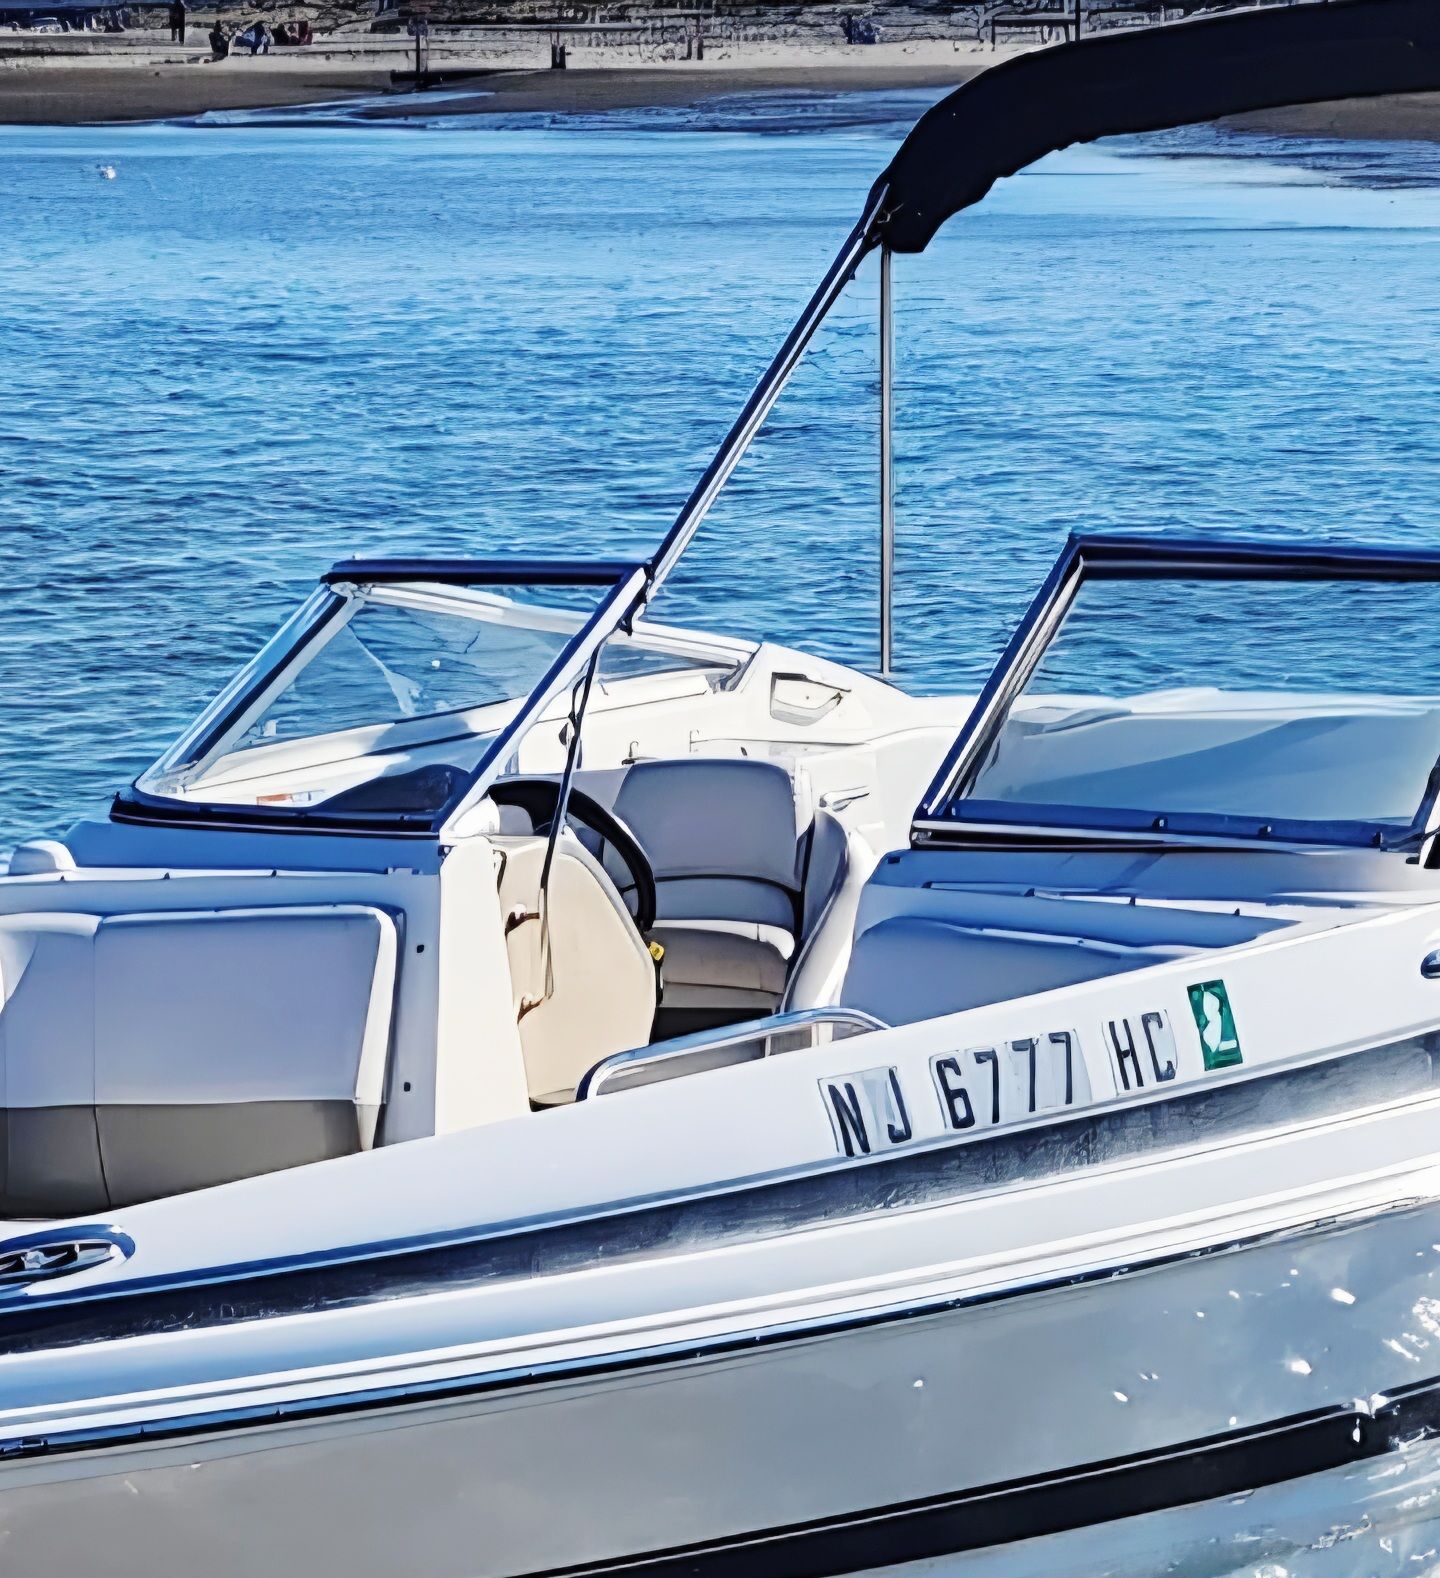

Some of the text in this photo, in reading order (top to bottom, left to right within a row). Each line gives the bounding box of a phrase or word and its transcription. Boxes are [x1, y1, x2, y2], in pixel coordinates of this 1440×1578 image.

[828, 1011, 1175, 1157] NJ 6777 HC
